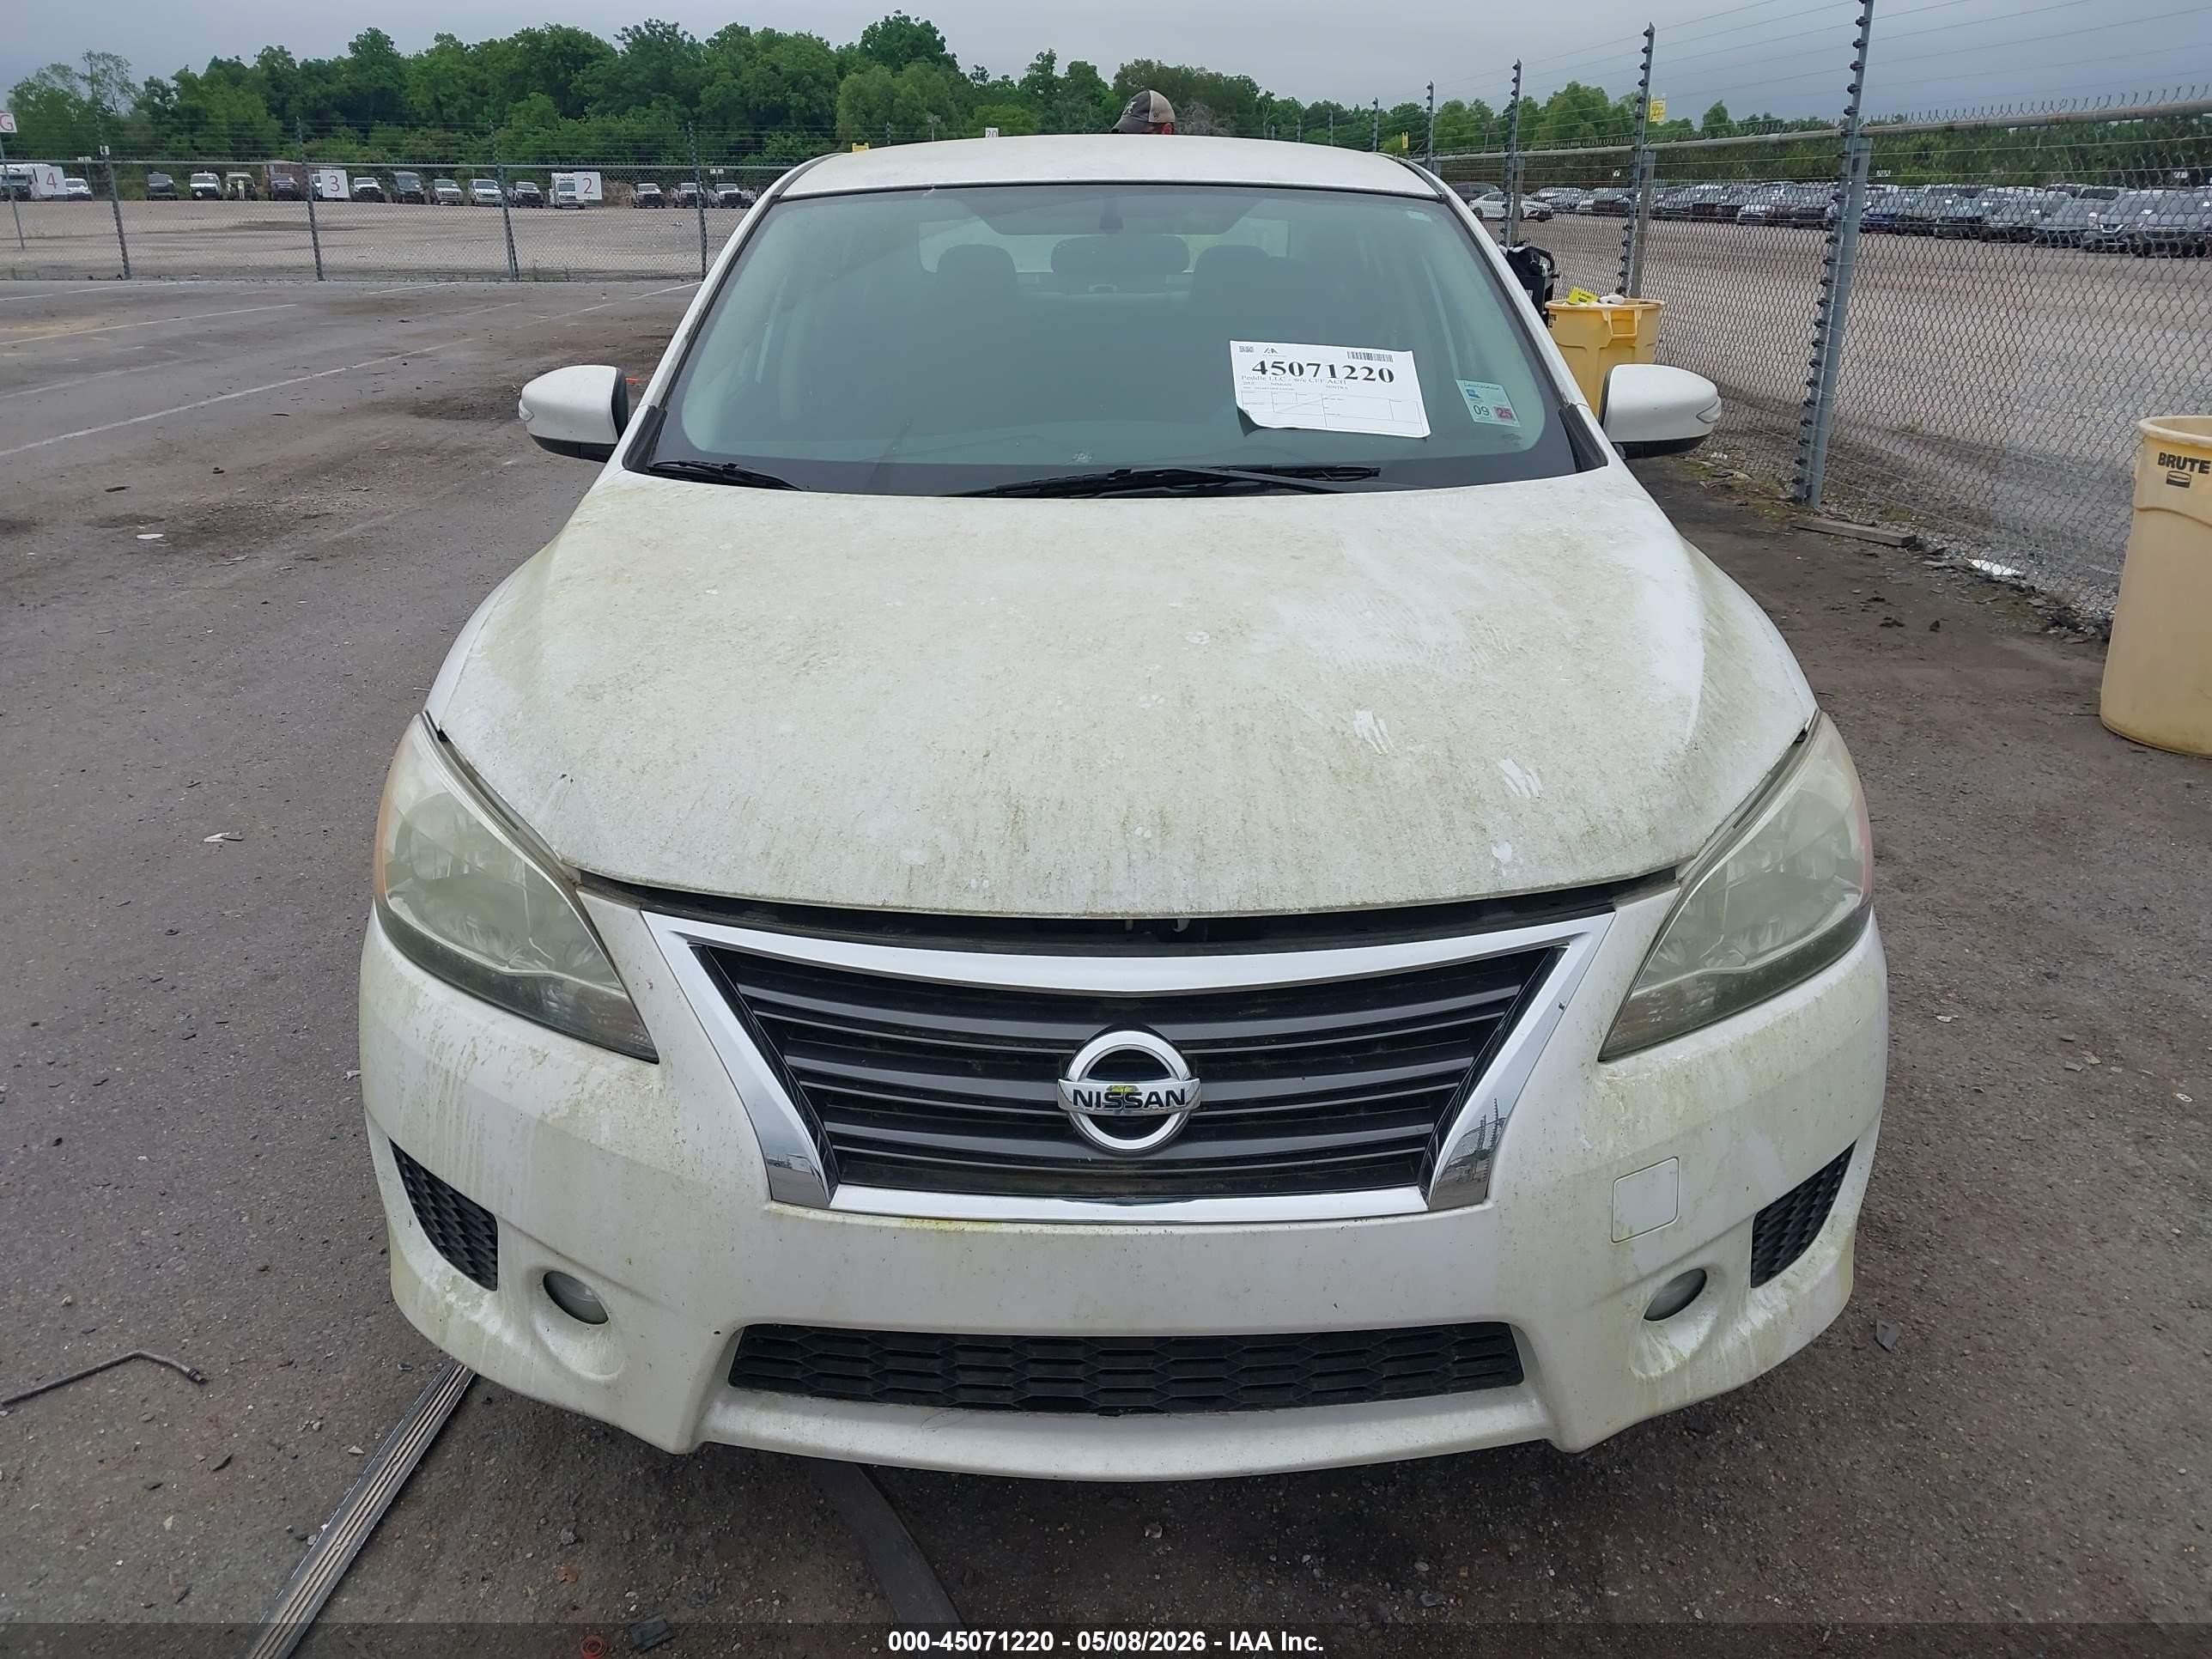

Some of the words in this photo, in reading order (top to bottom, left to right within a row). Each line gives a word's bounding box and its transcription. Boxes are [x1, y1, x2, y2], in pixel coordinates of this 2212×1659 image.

[0, 114, 14, 131] G
[46, 172, 58, 189] 4
[329, 175, 340, 191] 3
[583, 177, 594, 194] 2
[1252, 360, 1395, 383] 45071220
[1473, 404, 1490, 416] 09
[1496, 407, 1513, 419] 25
[2157, 452, 2212, 475] BRUTE
[1073, 1088, 1185, 1109] NISSAN
